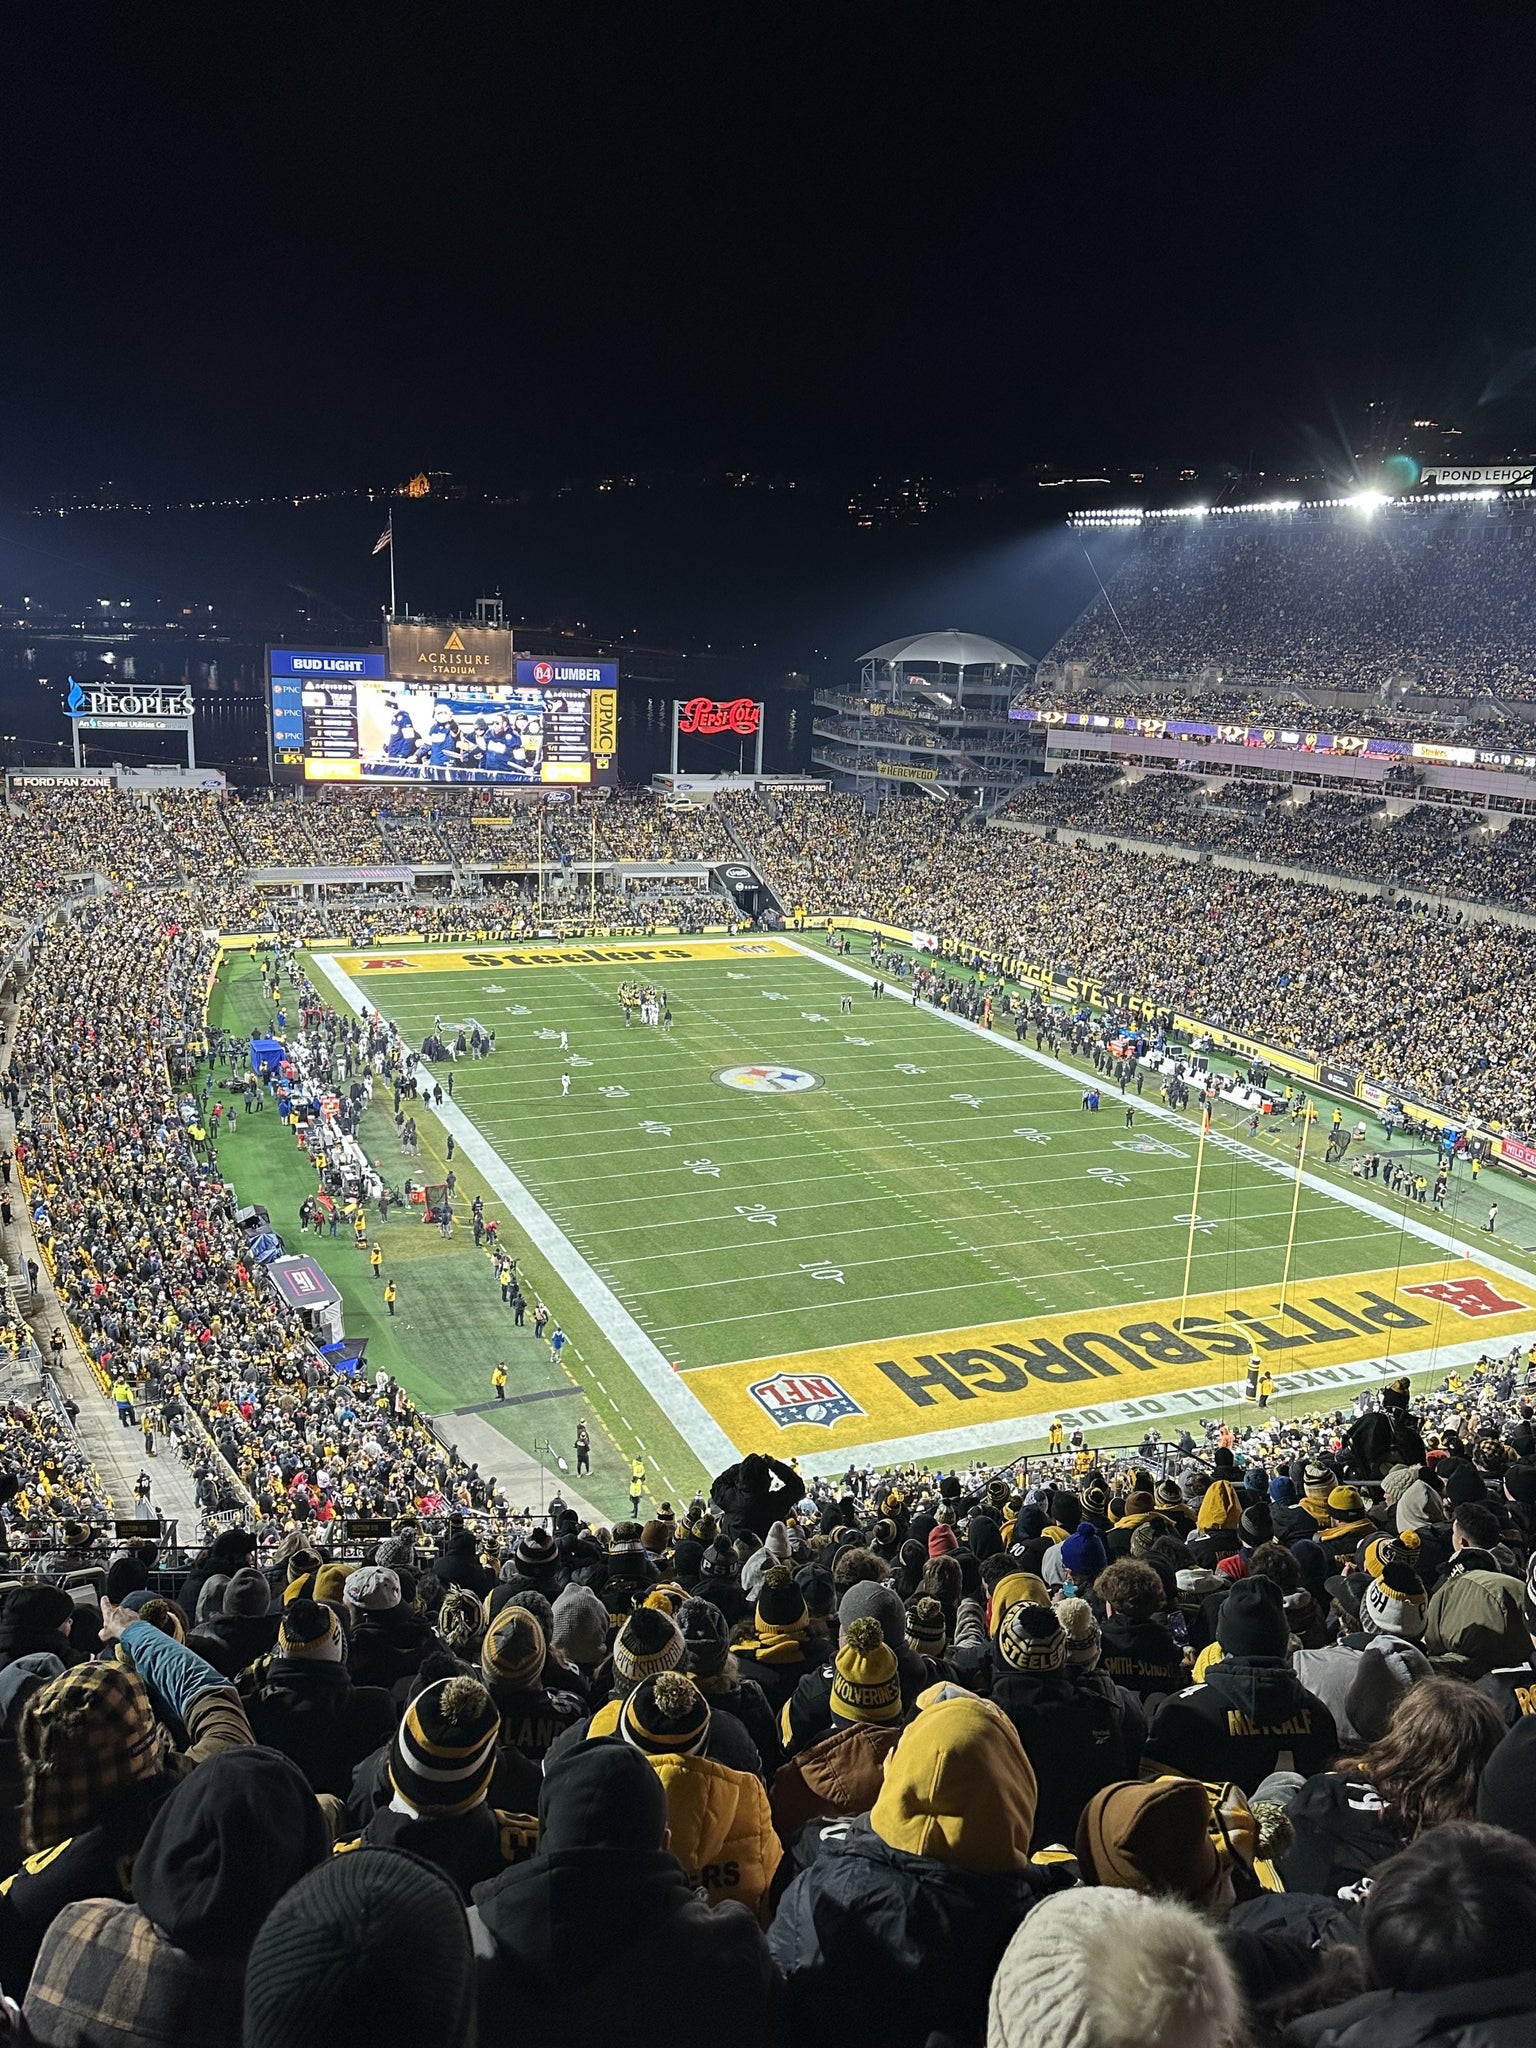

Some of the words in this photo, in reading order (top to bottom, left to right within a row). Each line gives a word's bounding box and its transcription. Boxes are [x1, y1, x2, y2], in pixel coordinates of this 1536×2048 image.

[1442, 470, 1482, 480] POND
[293, 658, 322, 671] BUD
[323, 660, 363, 672] LIGHT
[418, 652, 490, 665] ACRISURE
[432, 665, 476, 674] STADIUM
[536, 667, 551, 679] 84
[555, 667, 601, 681] LUMBER
[88, 692, 196, 716] PEOPLES
[284, 709, 301, 717] PNC
[599, 693, 613, 749] UPMC
[97, 720, 128, 728] Essential
[1480, 752, 1494, 763] 1ST
[1500, 754, 1511, 765] 10
[880, 764, 934, 780] #HEREWEGO
[24, 777, 55, 787] FORD
[56, 777, 79, 787] FAN
[81, 777, 111, 787] ZONE
[462, 949, 692, 967] Steelers
[598, 1084, 631, 1098] 50
[1505, 1144, 1524, 1159] WILD
[683, 1158, 718, 1176] 30
[734, 1203, 775, 1223] 20
[799, 1260, 844, 1281] 10
[874, 1291, 1432, 1408] PITTSBURGH
[757, 1378, 838, 1407] NFL
[1171, 1384, 1246, 1404] ALL
[1120, 1400, 1168, 1419] OF
[1055, 1409, 1110, 1429] US
[1009, 1543, 1026, 1557] 90
[834, 1673, 898, 1706] WOLVERINES
